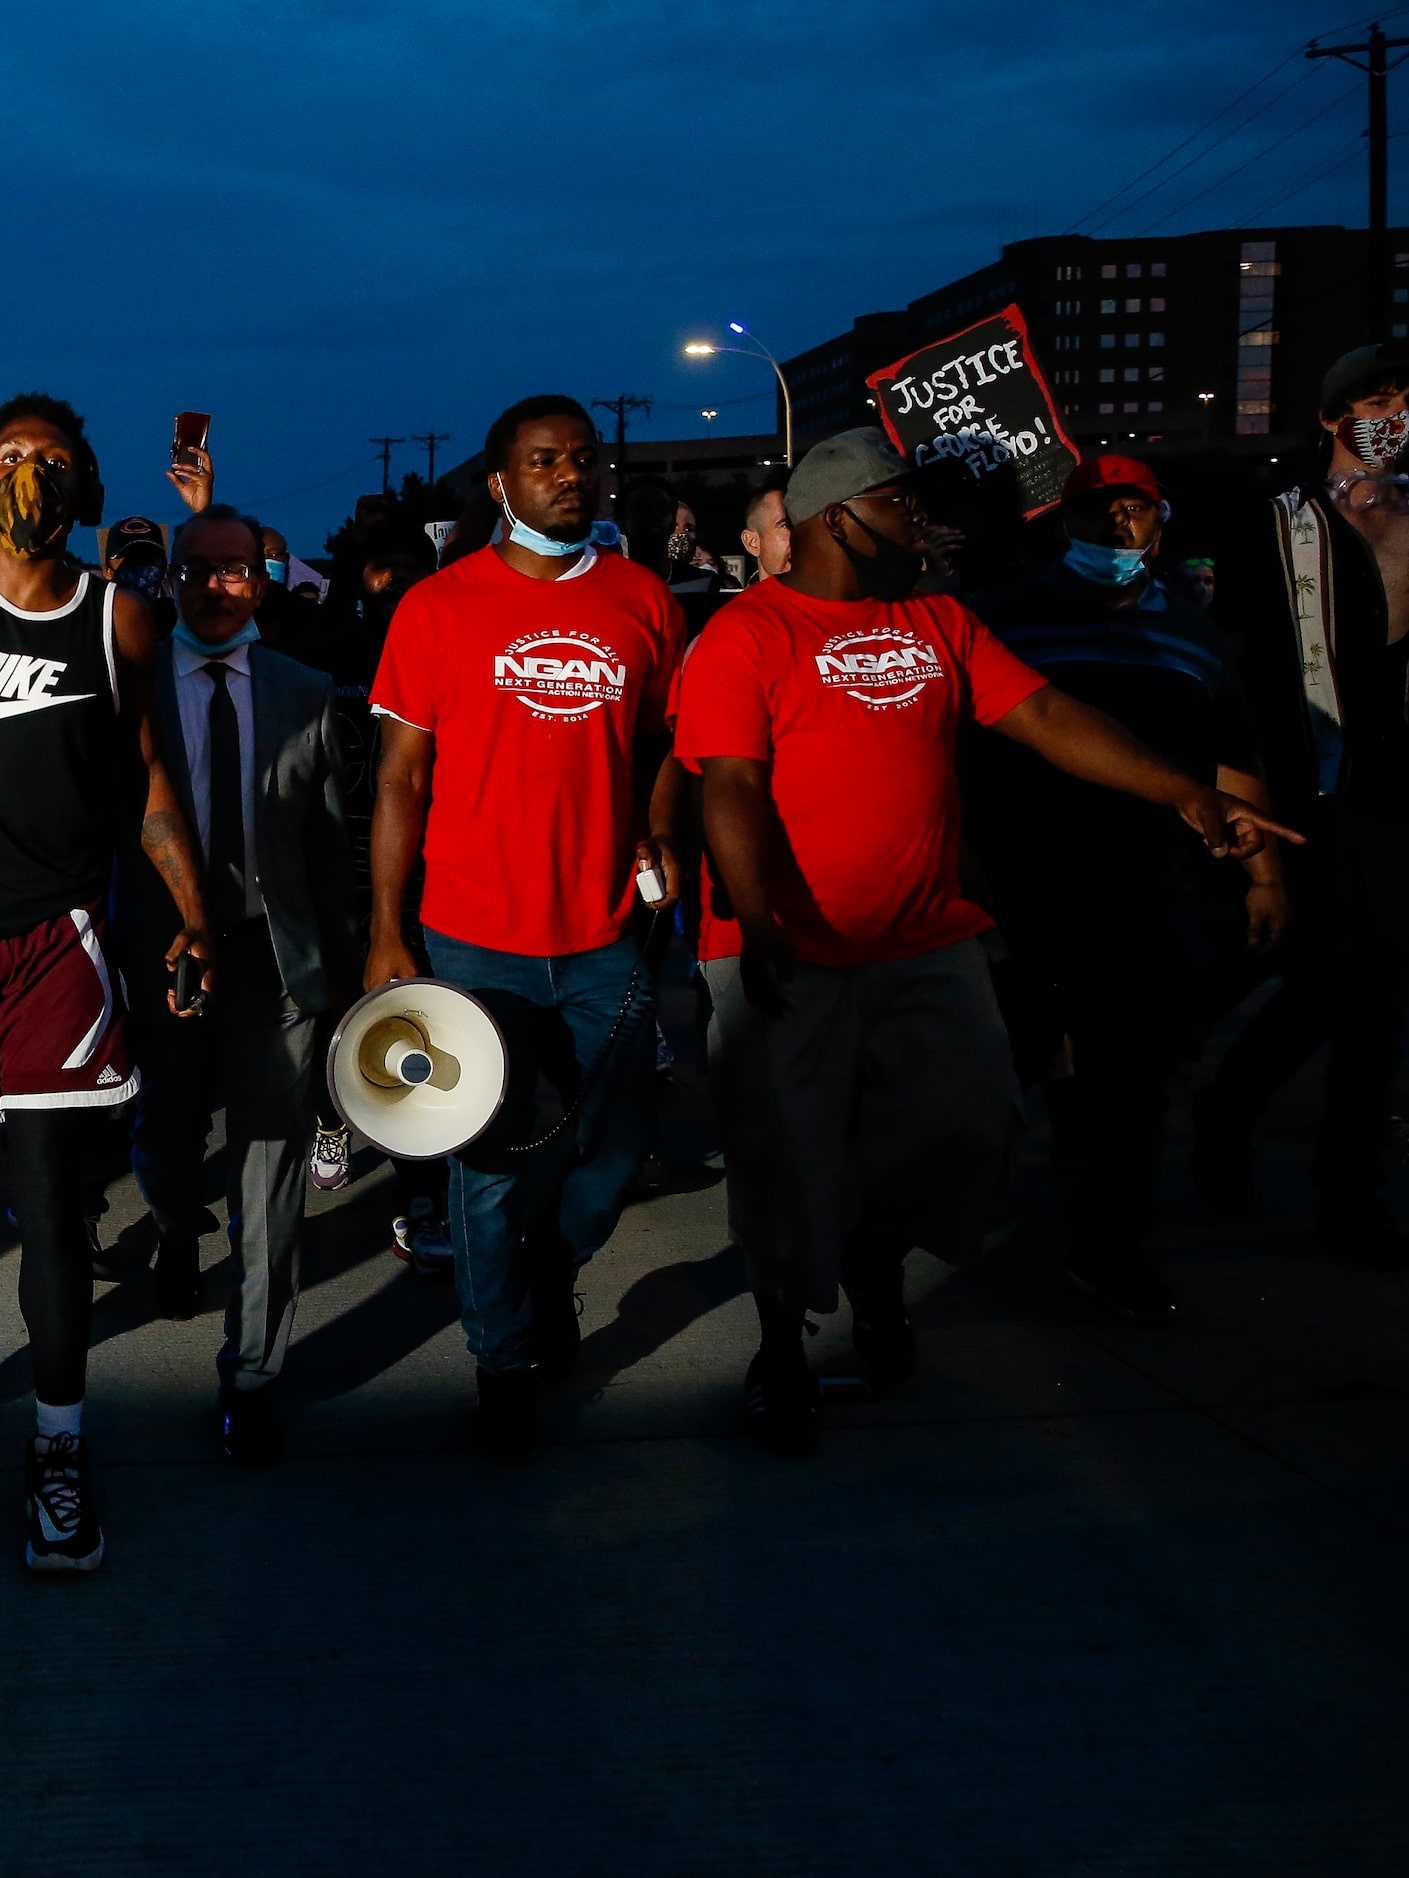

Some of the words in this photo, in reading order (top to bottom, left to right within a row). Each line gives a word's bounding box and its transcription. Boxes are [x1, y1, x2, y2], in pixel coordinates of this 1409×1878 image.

[890, 339, 1024, 414] JUSTICE
[933, 394, 986, 431] FOR
[504, 629, 560, 656] JUSTICE
[568, 630, 600, 645] FOR
[602, 645, 620, 664] ALL
[822, 630, 865, 655] JUSTICE
[872, 627, 901, 635] FOR
[494, 655, 626, 687] NGAN
[814, 644, 939, 676] NGAN
[822, 673, 856, 684] NEXT
[861, 665, 942, 682] GENERATION
[873, 677, 904, 688] ACTION
[905, 672, 944, 682] NETWORK
[494, 678, 532, 687] NEXT
[536, 680, 623, 696] GENERATION
[547, 689, 580, 697] ACTION
[582, 691, 621, 702] NETWORK
[562, 713, 589, 723] 2014
[96, 1075, 122, 1085] adidas
